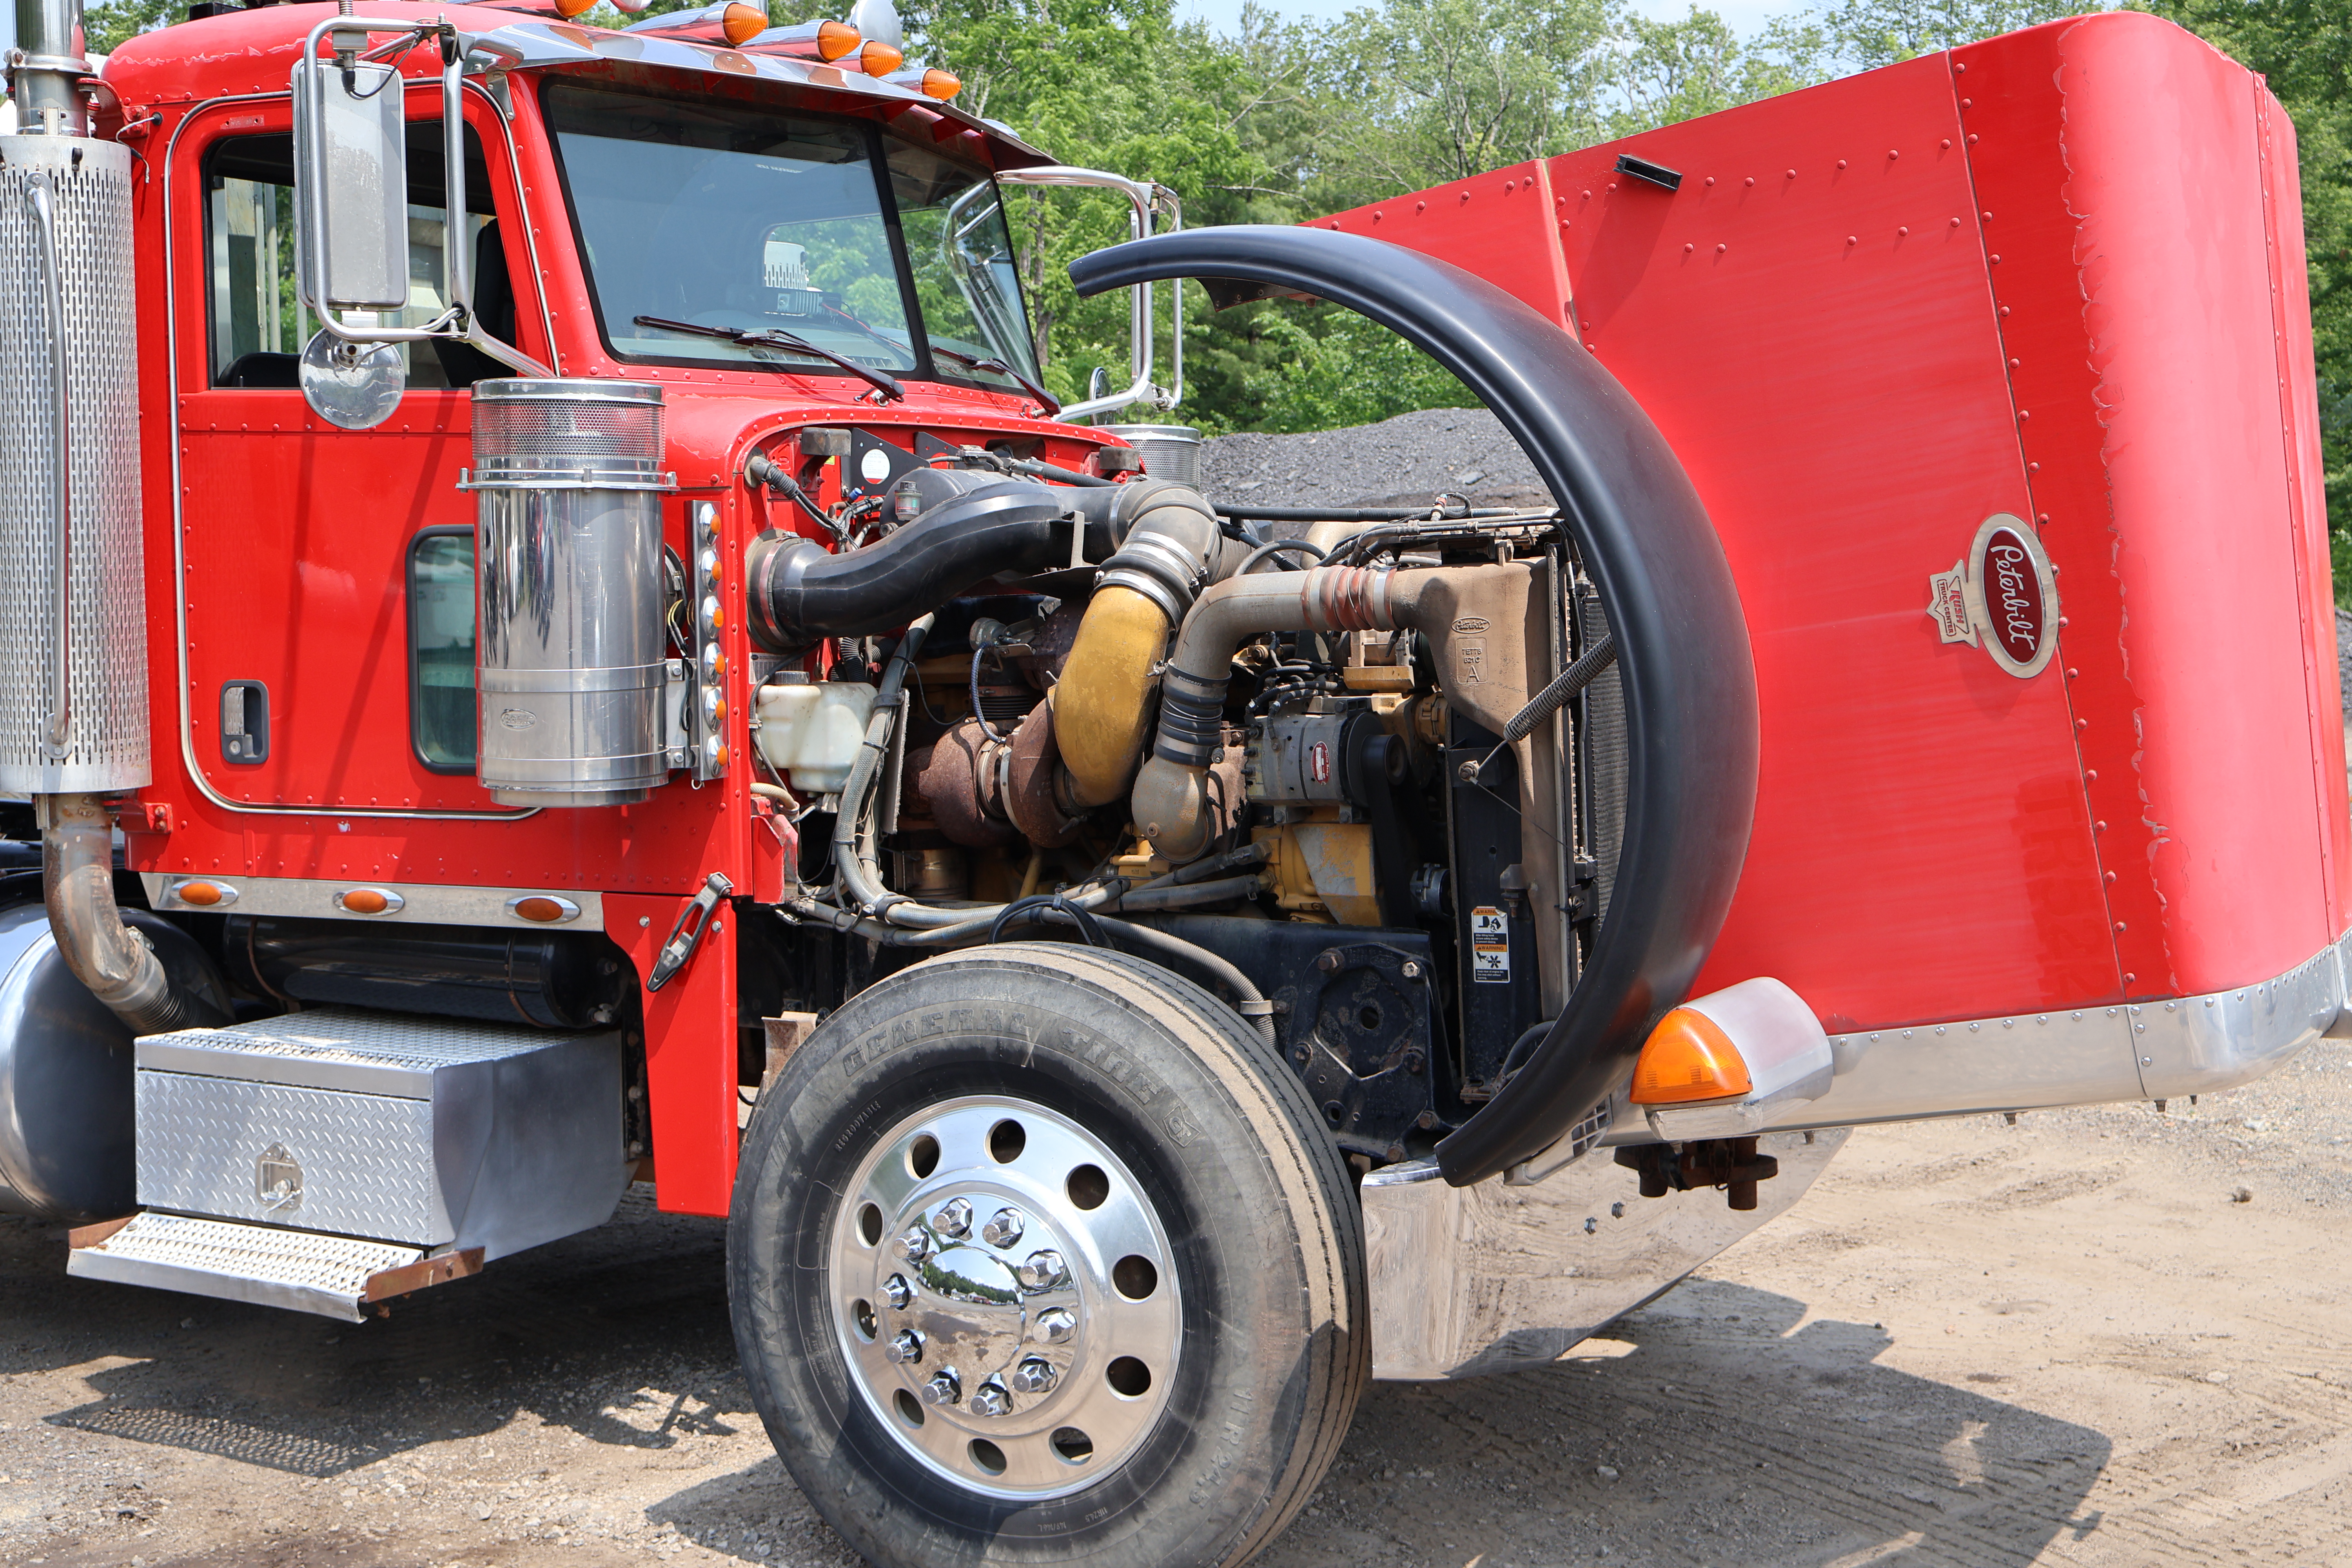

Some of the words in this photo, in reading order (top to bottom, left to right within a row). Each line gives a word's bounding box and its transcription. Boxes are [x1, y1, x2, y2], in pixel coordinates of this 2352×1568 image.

[1940, 581, 1949, 606] TRUCK
[1990, 545, 2035, 651] Peterbilt
[1944, 606, 1954, 635] CENTER
[1178, 675, 1203, 686] DYNACRAFT
[1466, 665, 1480, 683] A
[842, 1008, 1034, 1076] GENERAL
[1062, 1026, 1161, 1105] TIRE
[833, 1100, 882, 1152] REGROOVABLE
